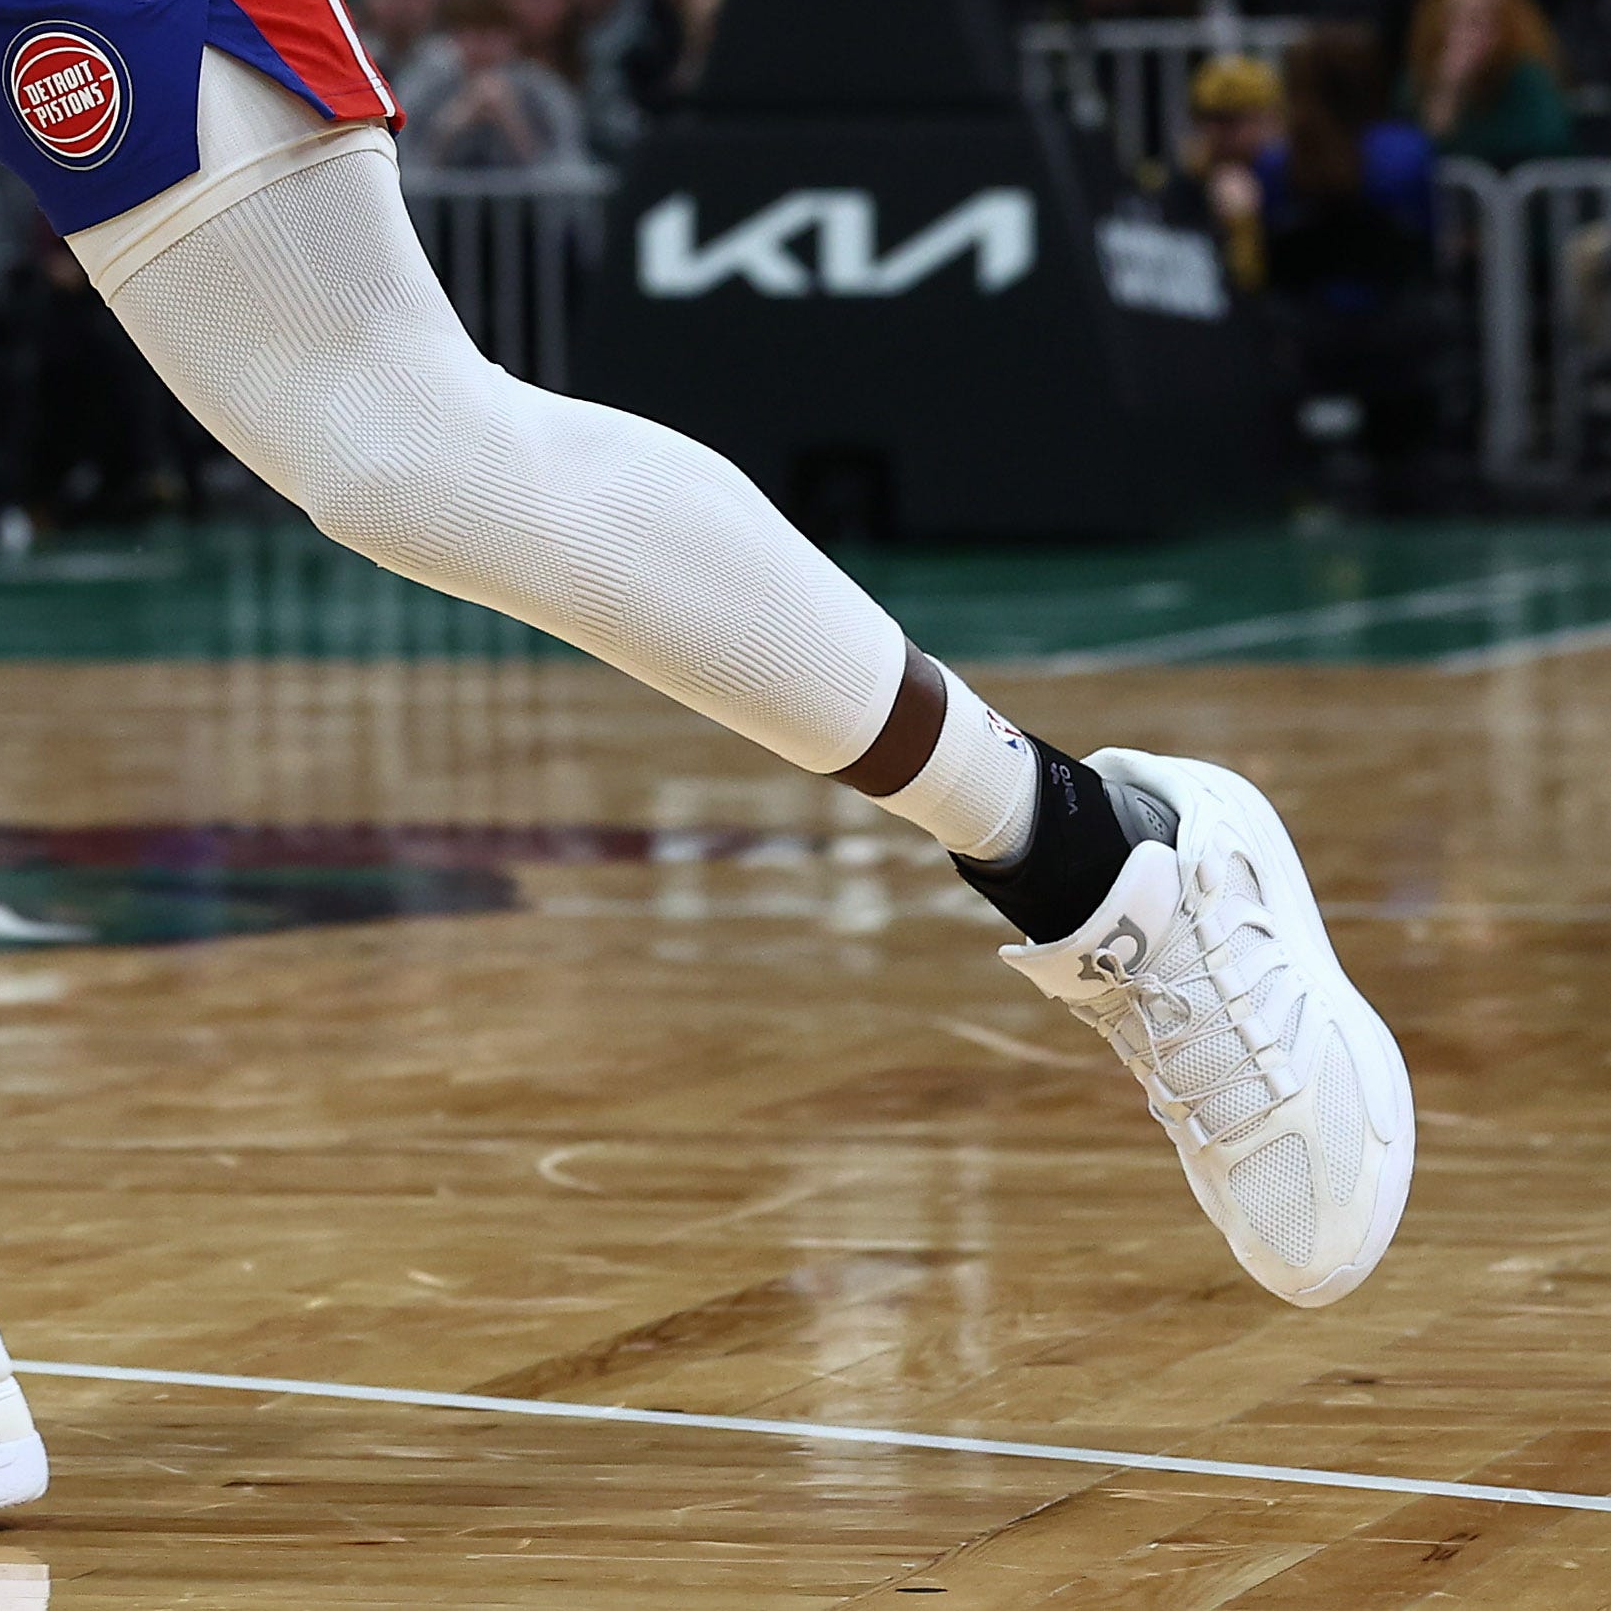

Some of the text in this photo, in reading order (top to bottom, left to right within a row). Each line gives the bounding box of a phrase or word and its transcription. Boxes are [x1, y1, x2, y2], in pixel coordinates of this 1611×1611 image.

[23, 60, 94, 106] DETROIT
[33, 81, 105, 129] PISTONS
[637, 187, 1035, 299] KIA
